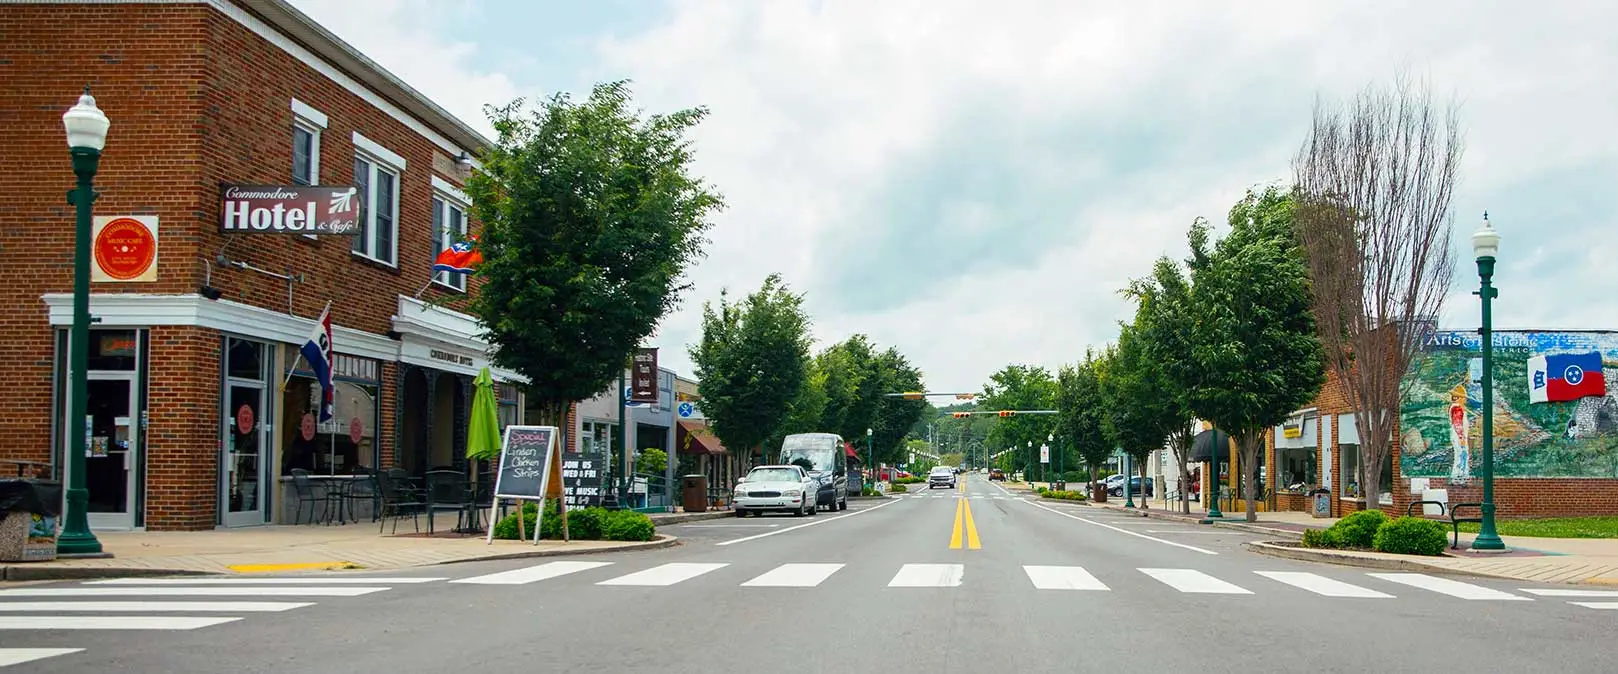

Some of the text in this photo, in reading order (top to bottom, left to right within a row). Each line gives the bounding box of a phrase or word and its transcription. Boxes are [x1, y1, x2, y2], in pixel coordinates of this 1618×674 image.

[226, 187, 298, 199] Commodore
[224, 201, 317, 231] Hotel
[1427, 334, 1461, 346] Arts
[511, 431, 545, 443] Special
[507, 445, 537, 456] Linden
[511, 456, 540, 467] Chicken
[562, 461, 592, 469] JOIN US
[512, 467, 540, 478] Strips
[563, 470, 578, 478] WED
[584, 470, 596, 478] FRI
[576, 487, 598, 496] MUSIC
[564, 496, 576, 504] FRI
